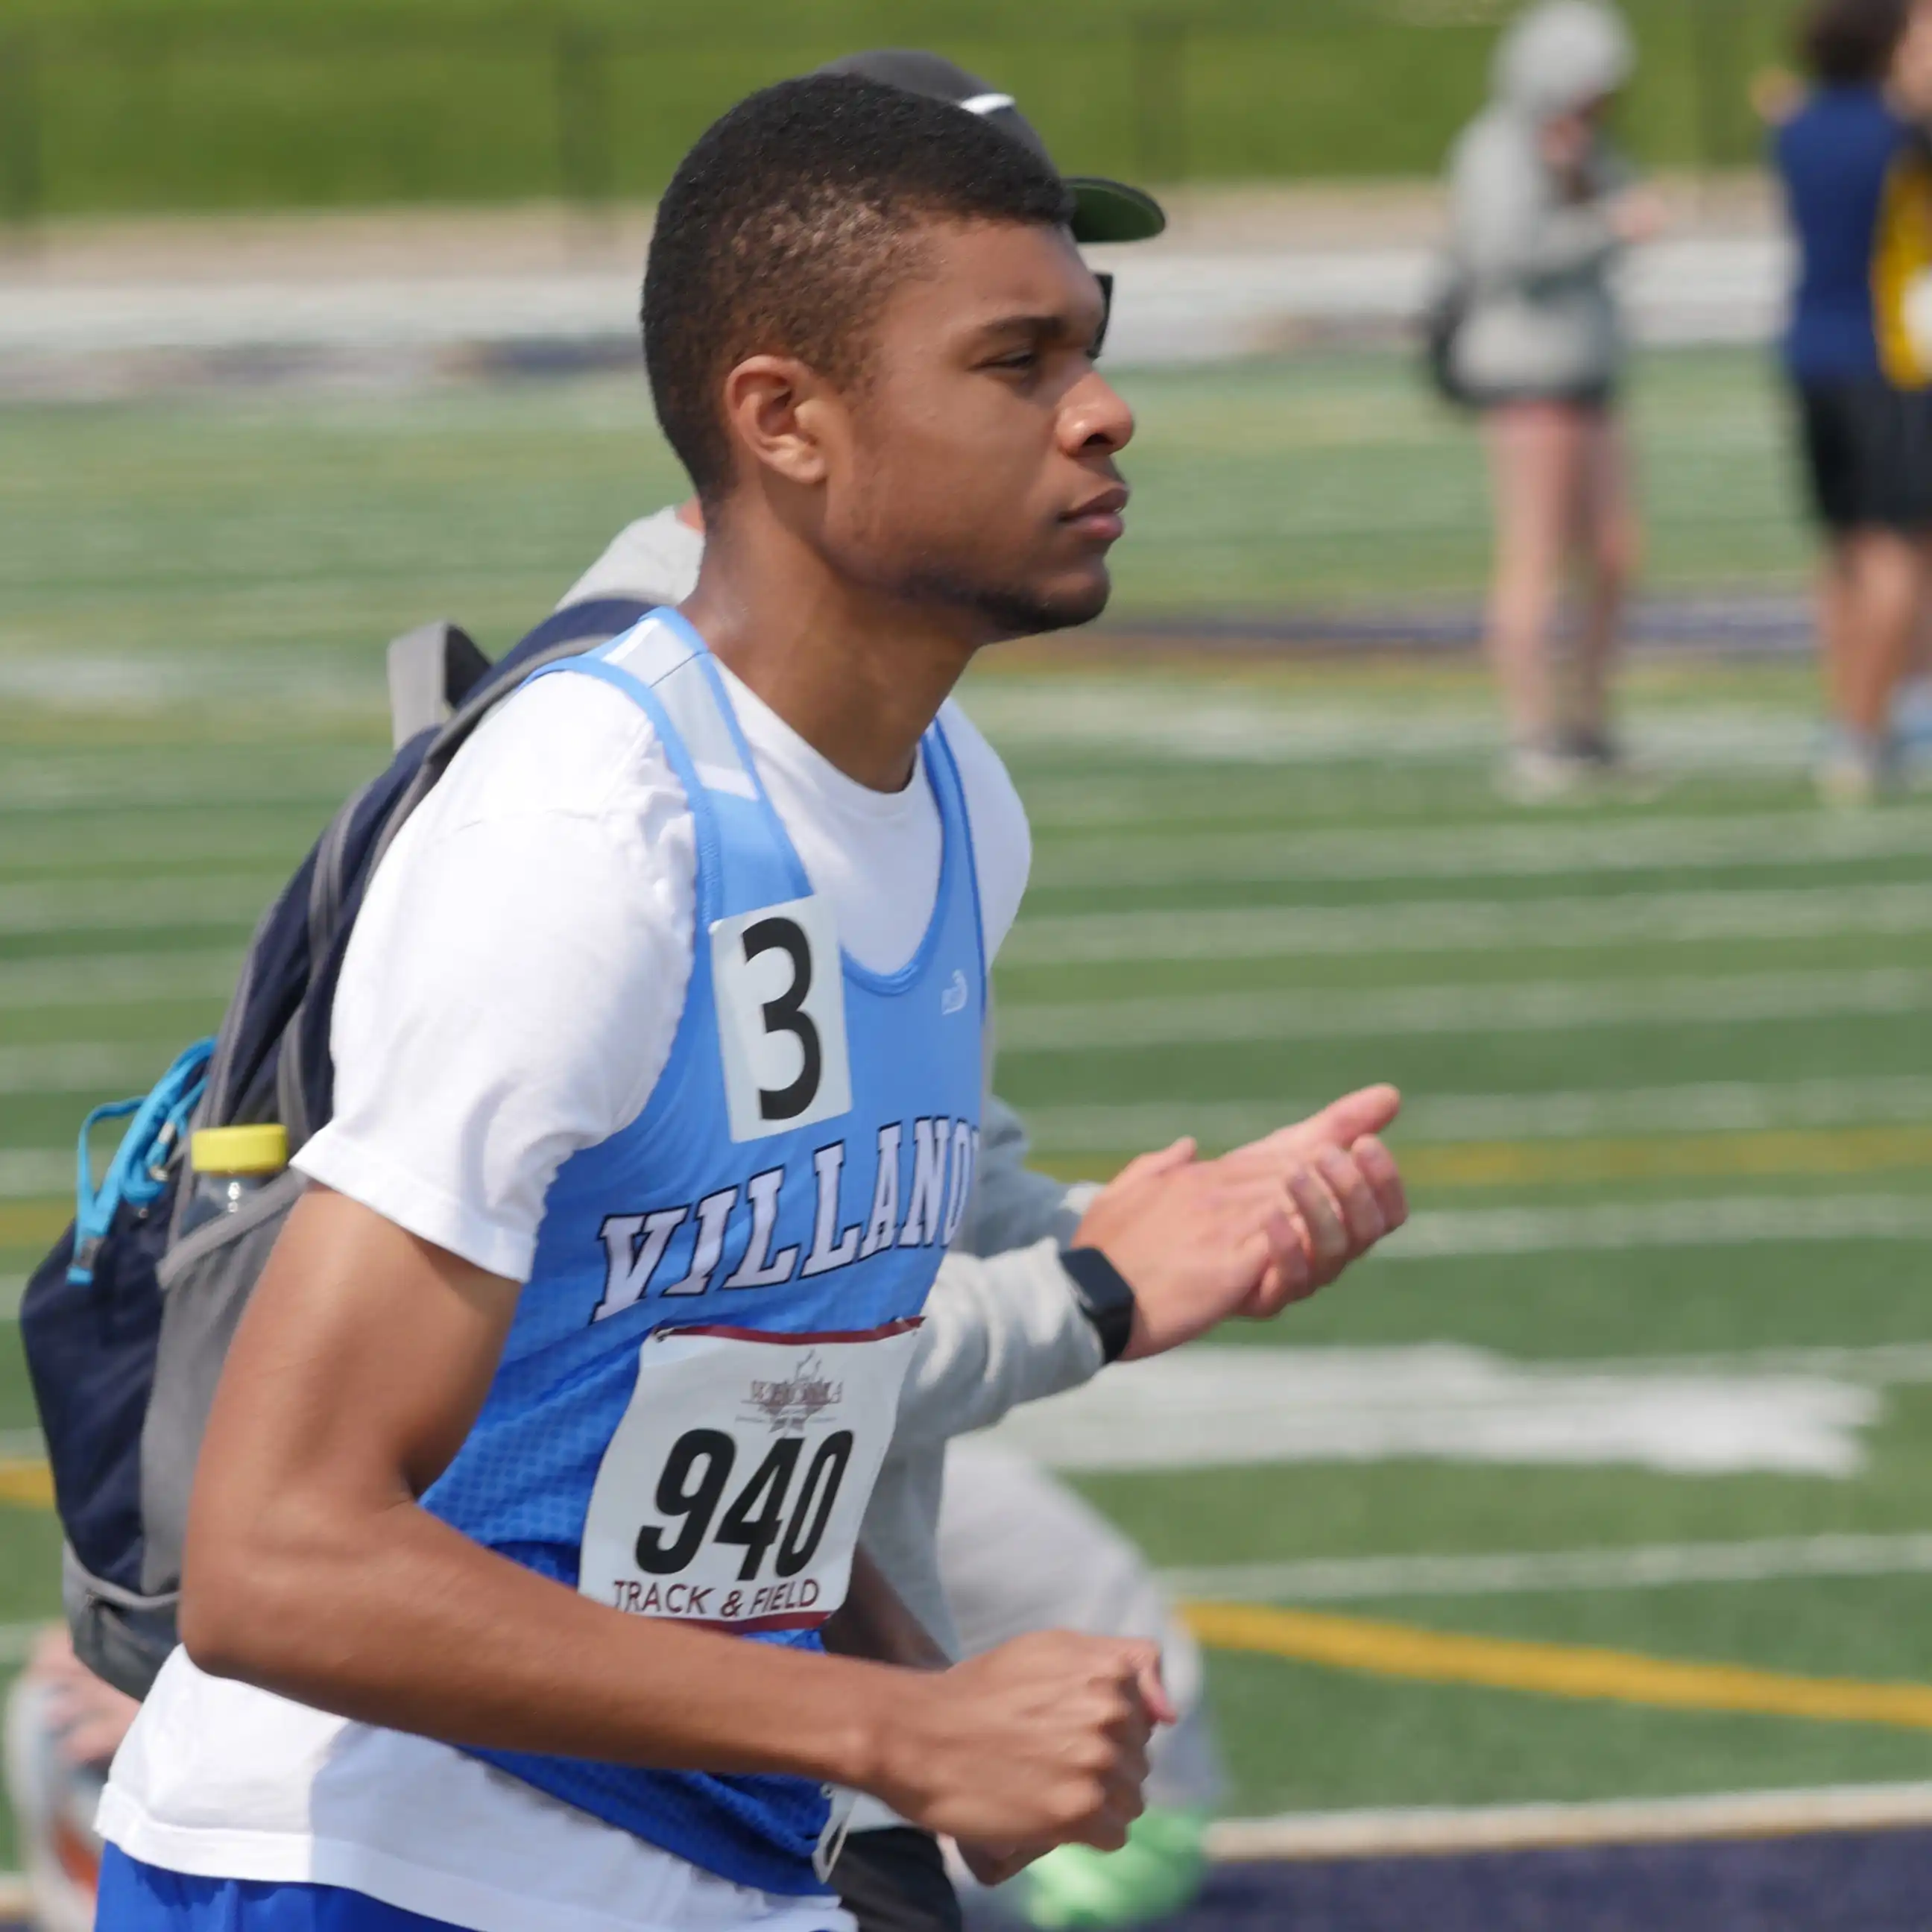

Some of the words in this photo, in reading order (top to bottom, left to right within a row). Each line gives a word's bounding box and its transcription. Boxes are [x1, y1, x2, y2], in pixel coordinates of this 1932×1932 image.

[742, 917, 821, 1121] 3
[589, 1115, 979, 1325] VILLANO
[635, 1427, 855, 1582] 940
[613, 1579, 716, 1614] TRACK
[719, 1588, 744, 1617] &
[748, 1578, 820, 1615] FIELD
